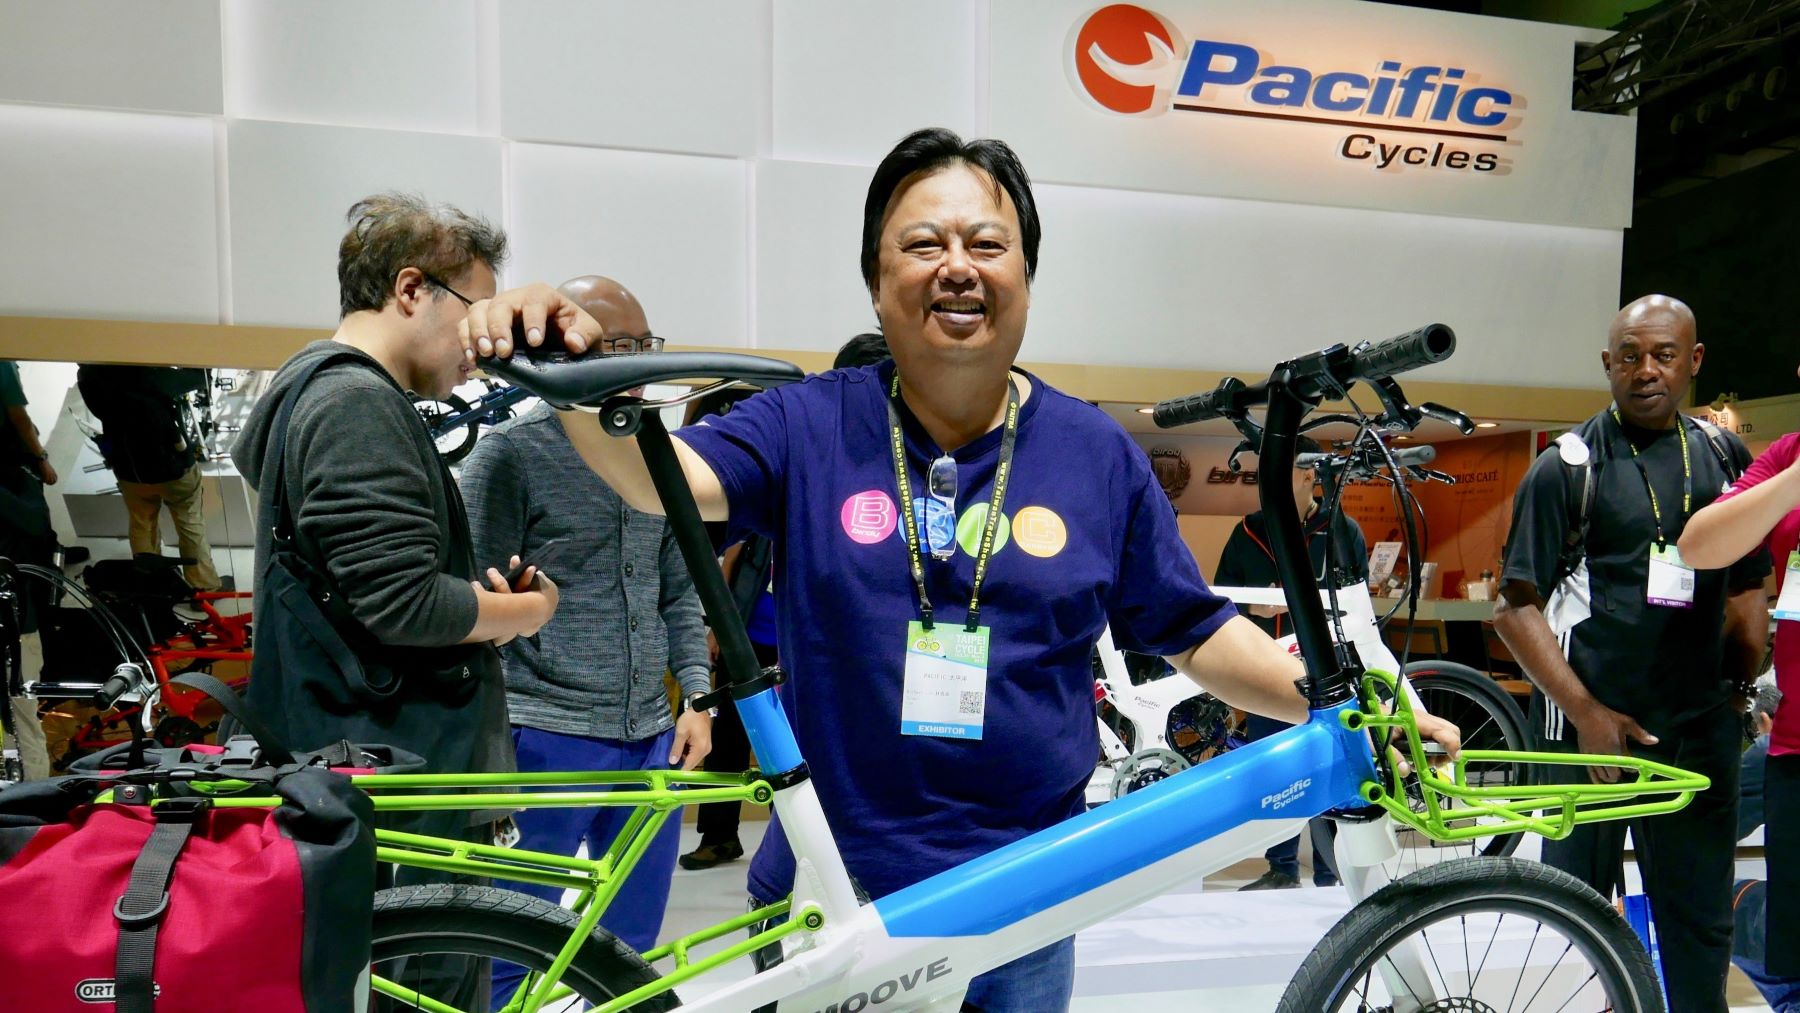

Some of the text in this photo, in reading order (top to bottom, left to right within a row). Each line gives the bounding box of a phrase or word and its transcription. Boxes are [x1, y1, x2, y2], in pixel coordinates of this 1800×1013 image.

[1177, 39, 1512, 127] Pacific
[1341, 133, 1498, 171] Cycles
[1206, 465, 1260, 485] bird
[851, 496, 890, 529] B
[969, 461, 1008, 610] www.TaiwanTradeShows.cotw
[955, 634, 986, 645] TAIPEI
[918, 725, 965, 735] EXHIBITOR
[1261, 778, 1312, 809] Pacific
[1273, 791, 1305, 810] Cycles
[82, 985, 116, 997] ORT
